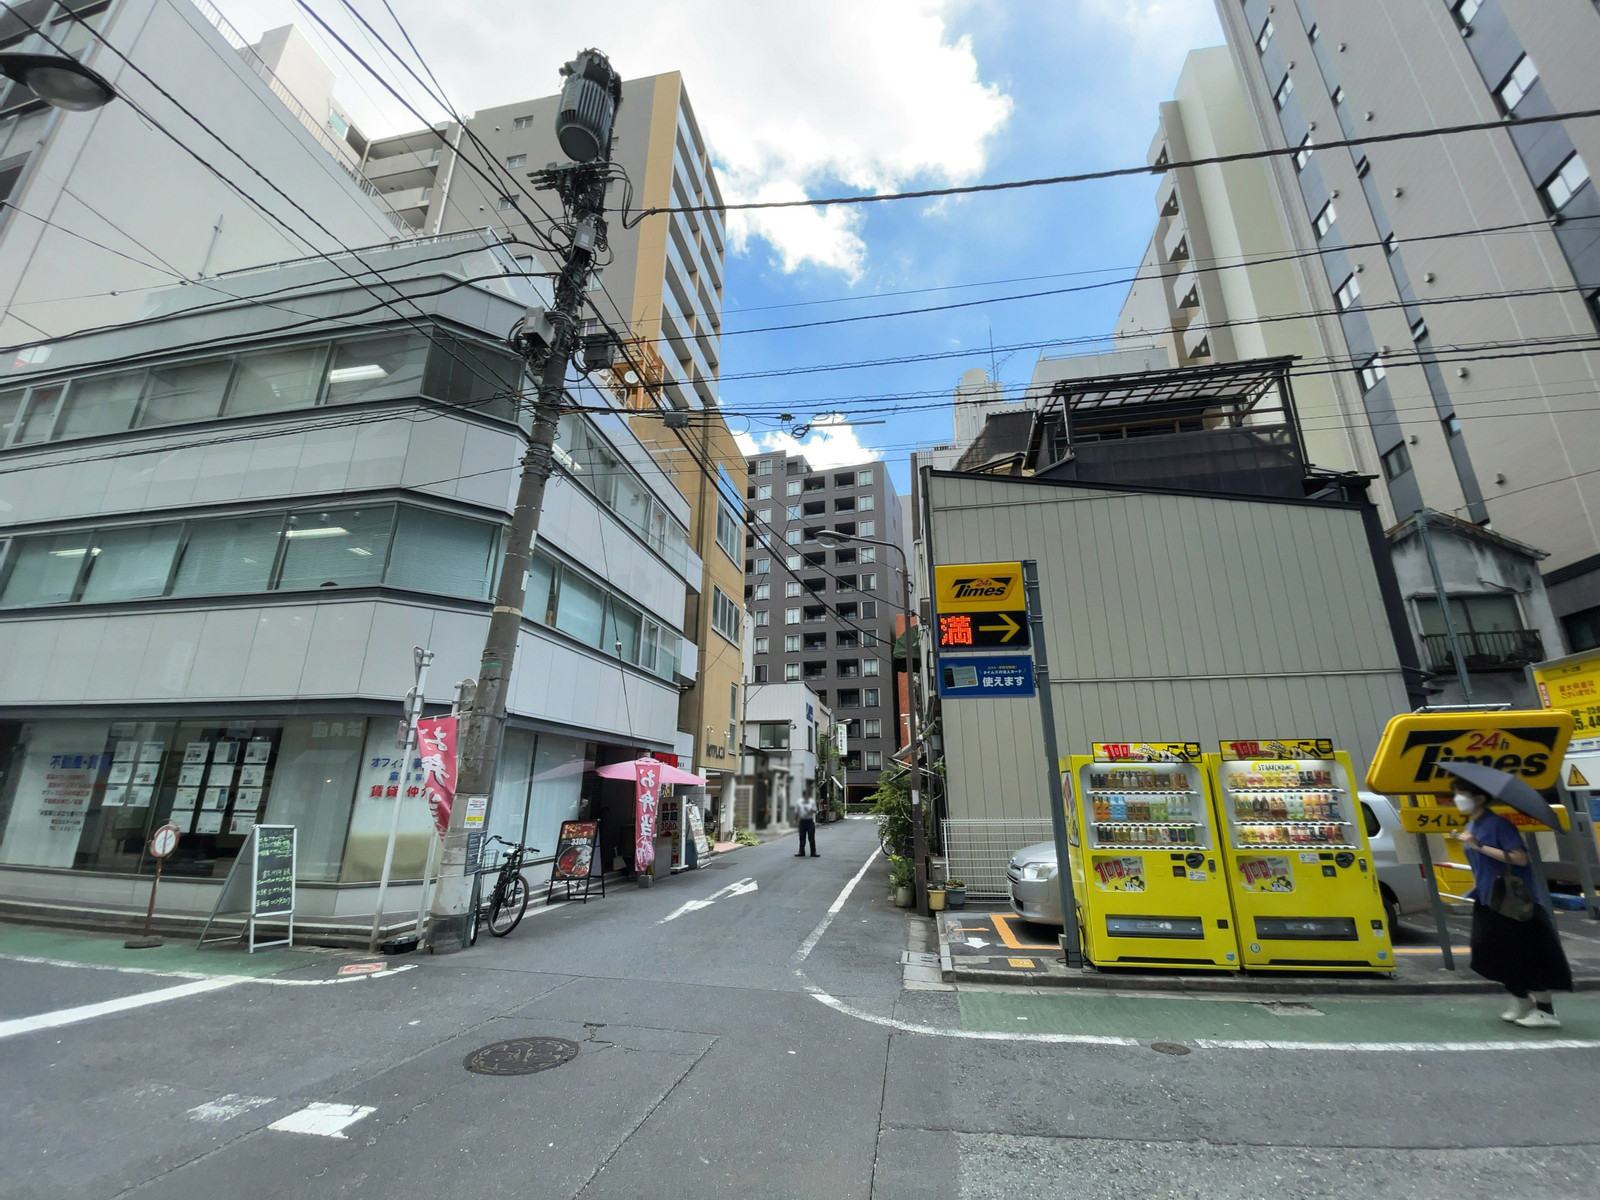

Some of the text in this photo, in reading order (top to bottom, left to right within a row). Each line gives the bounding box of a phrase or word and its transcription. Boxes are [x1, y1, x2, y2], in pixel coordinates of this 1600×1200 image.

[953, 583, 1007, 599] Times
[939, 615, 973, 646] 満
[982, 676, 1024, 688] 使えます
[1230, 742, 1260, 759] 100
[1466, 732, 1509, 752] 24h
[1103, 743, 1131, 760] 100
[1094, 860, 1126, 884] 100
[1239, 860, 1272, 884] 100
